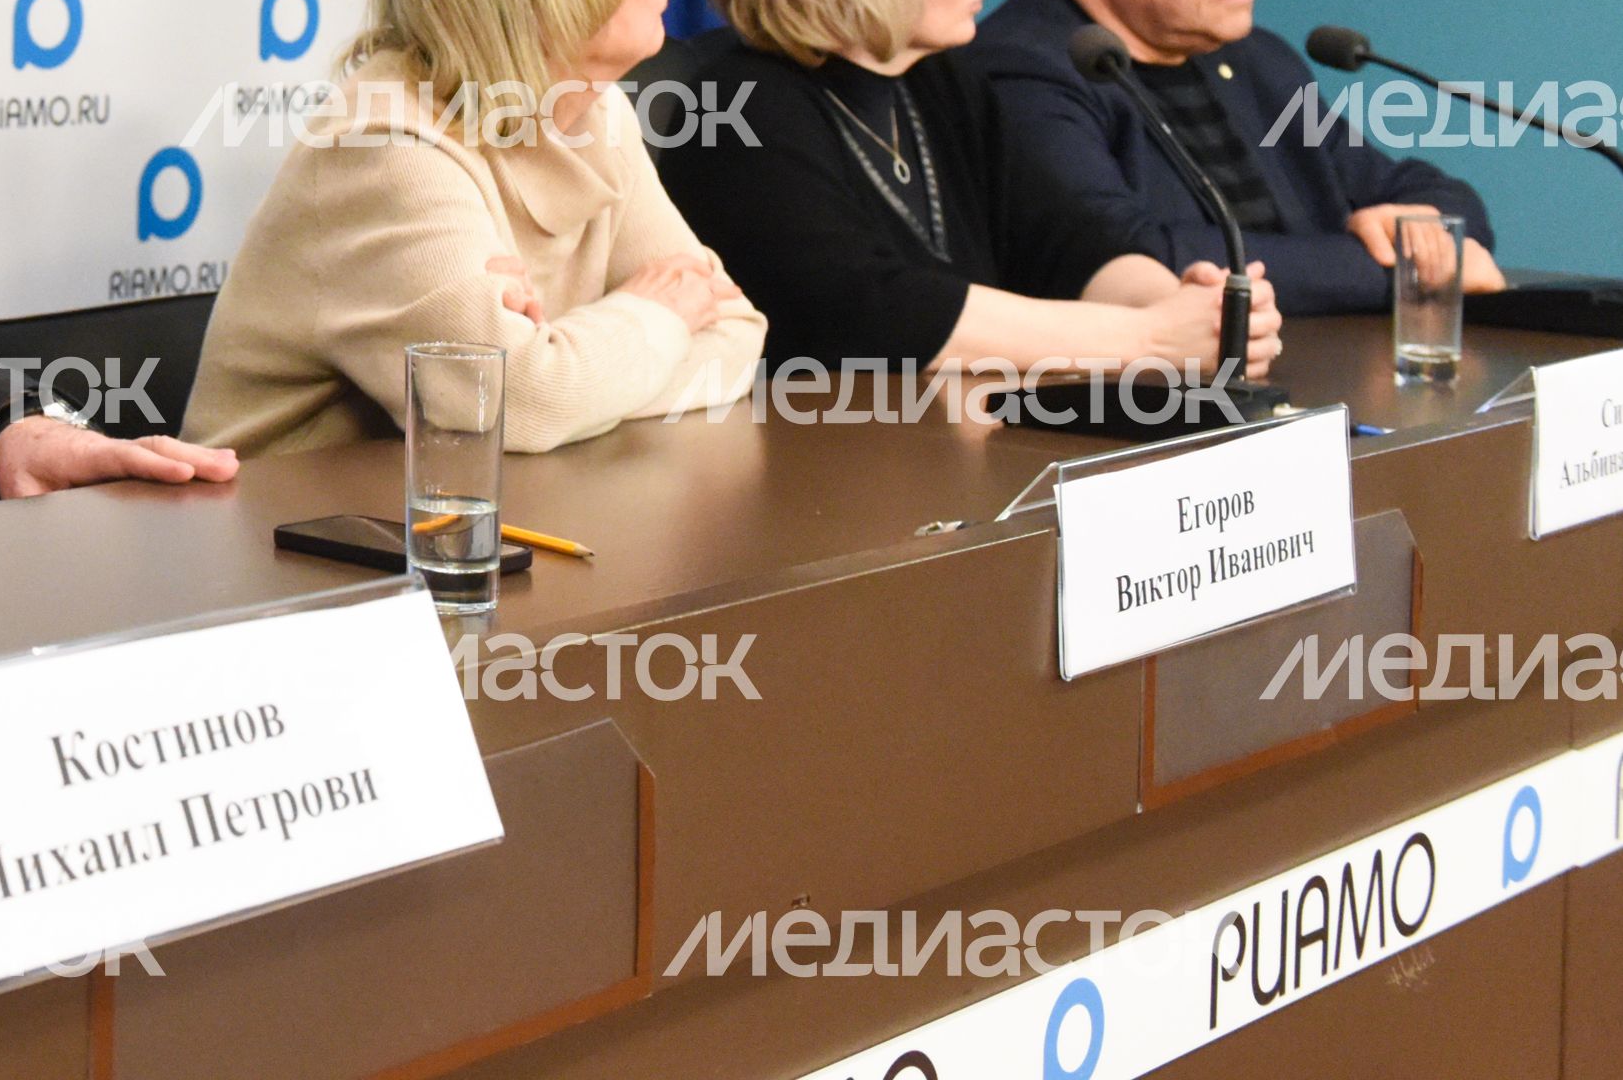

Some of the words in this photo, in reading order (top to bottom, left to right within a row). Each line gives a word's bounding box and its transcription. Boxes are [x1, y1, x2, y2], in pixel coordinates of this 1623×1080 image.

[1177, 489, 1255, 534] Егоров
[1116, 564, 1202, 613] Виктор
[1207, 530, 1315, 584] Иванович
[49, 703, 286, 788] Костинов
[177, 767, 380, 850] Петрови
